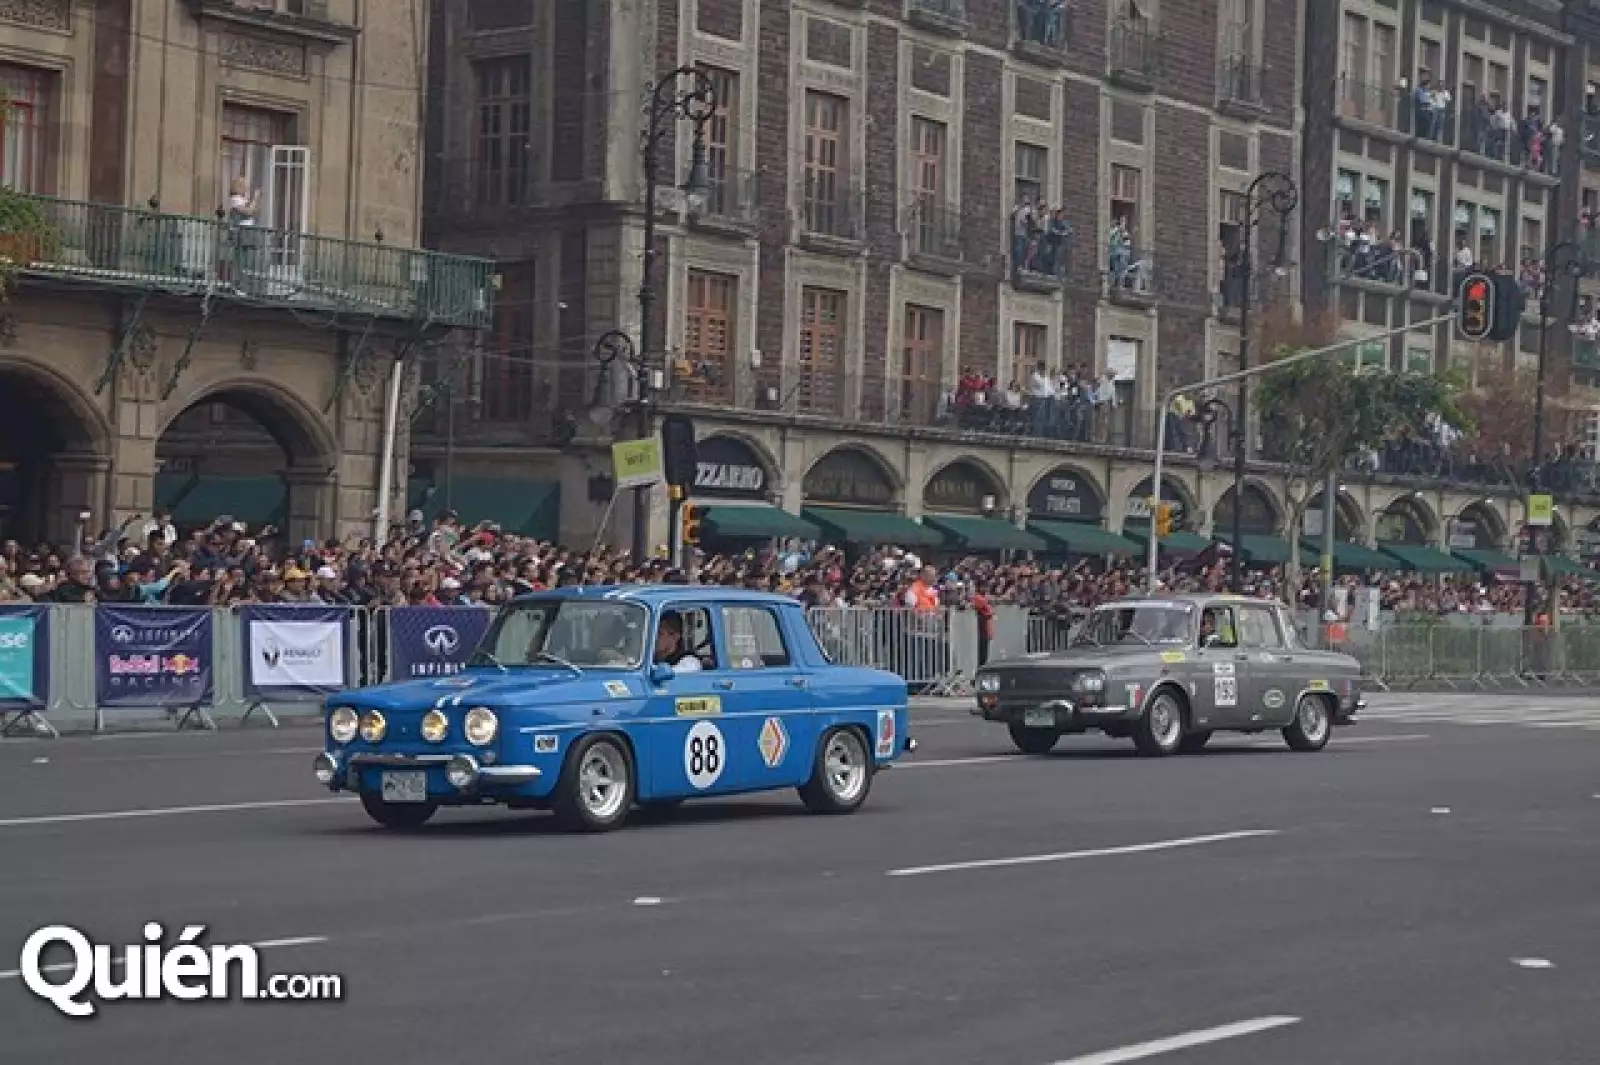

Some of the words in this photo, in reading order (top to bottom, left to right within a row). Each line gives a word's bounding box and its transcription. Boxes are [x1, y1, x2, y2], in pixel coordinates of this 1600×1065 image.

[694, 462, 764, 490] ZZARRO
[411, 661, 467, 676] INFINI
[688, 734, 719, 776] 88
